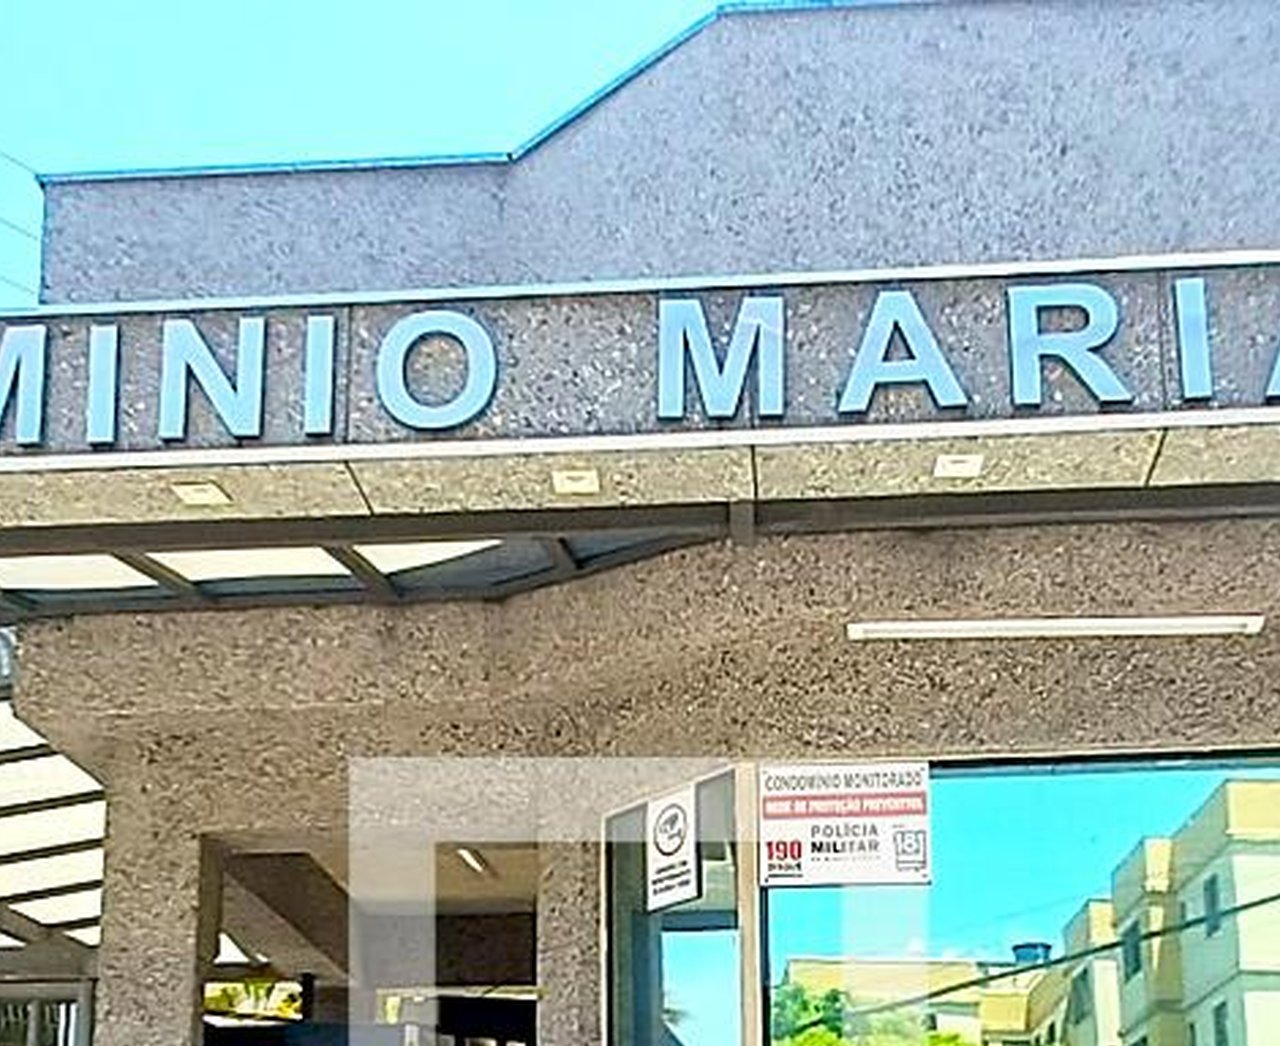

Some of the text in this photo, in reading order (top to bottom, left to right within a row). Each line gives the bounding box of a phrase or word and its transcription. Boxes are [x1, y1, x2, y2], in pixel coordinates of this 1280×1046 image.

[844, 770, 922, 788] MONITORADO
[766, 840, 803, 861] 190
[811, 839, 880, 854] MILITAR
